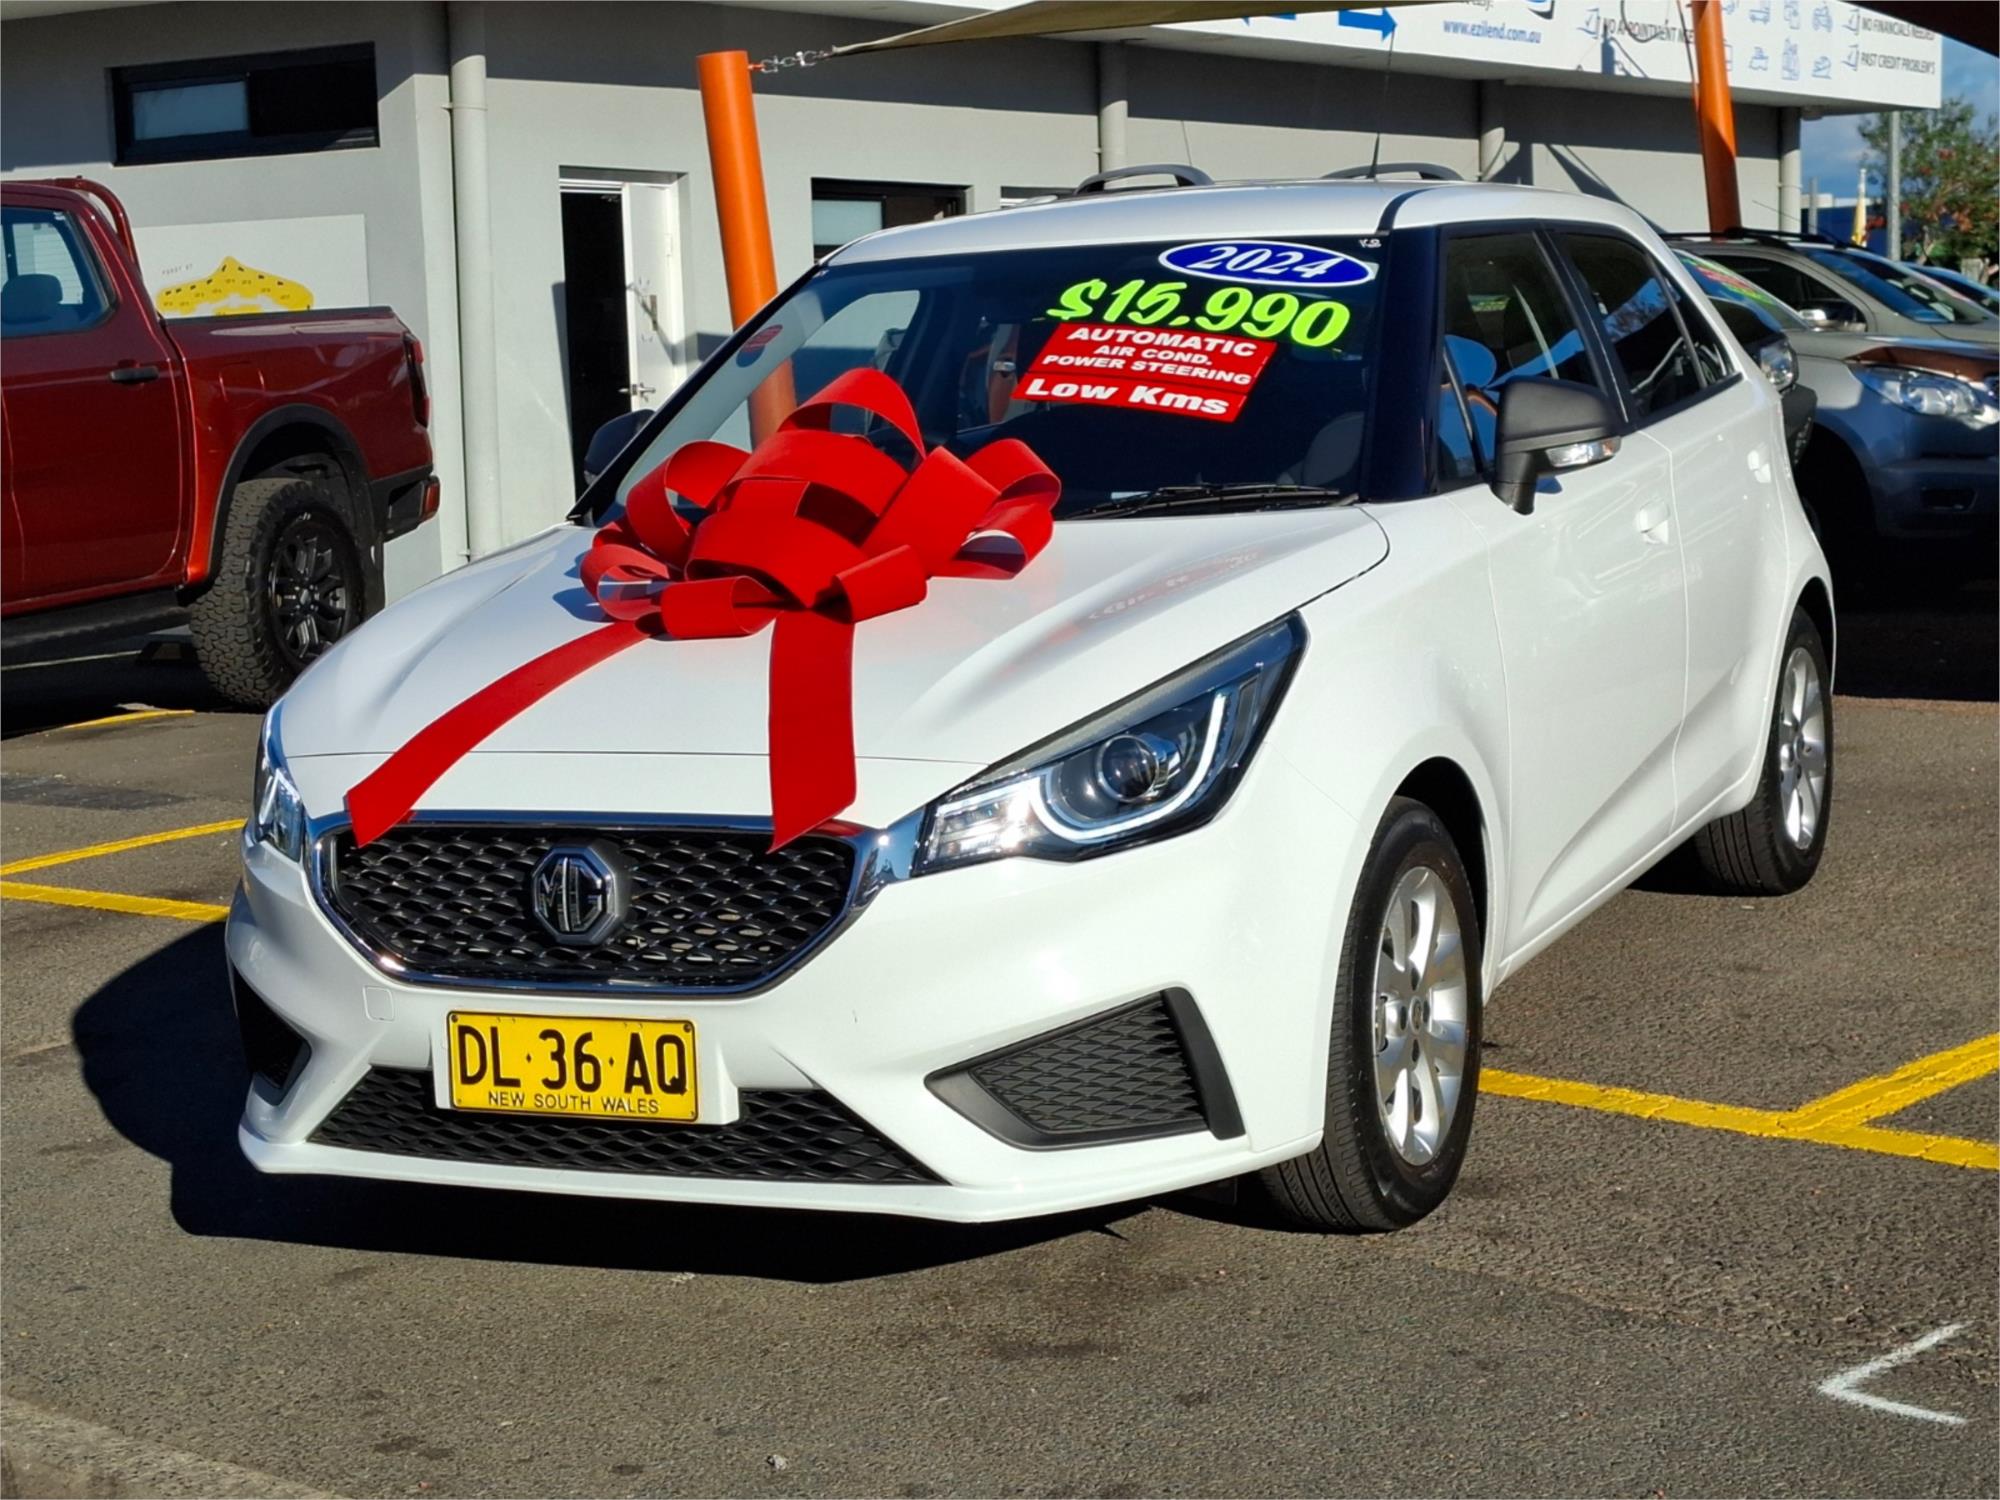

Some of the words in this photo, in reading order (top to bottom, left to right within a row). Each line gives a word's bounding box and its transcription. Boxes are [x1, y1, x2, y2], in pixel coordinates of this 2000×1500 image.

[1443, 20, 1542, 44] www.ezilend.com.au
[1873, 19, 1911, 37] FINANCIALS
[1861, 51, 1878, 67] PAST
[1878, 54, 1901, 70] CREDIT
[1187, 246, 1346, 279] 2024
[1046, 279, 1350, 347] $15.990
[1067, 327, 1257, 357] AUTOMATIC
[1094, 345, 1137, 358] AIR
[1141, 348, 1212, 366] COND.
[1042, 355, 1124, 371] POWER
[1130, 360, 1251, 385] STEERING
[1129, 386, 1229, 415] Kms
[538, 856, 602, 932] MG
[488, 1091, 525, 1107] NEW
[534, 1094, 591, 1111] SOUTH
[601, 1096, 659, 1114] WALES
